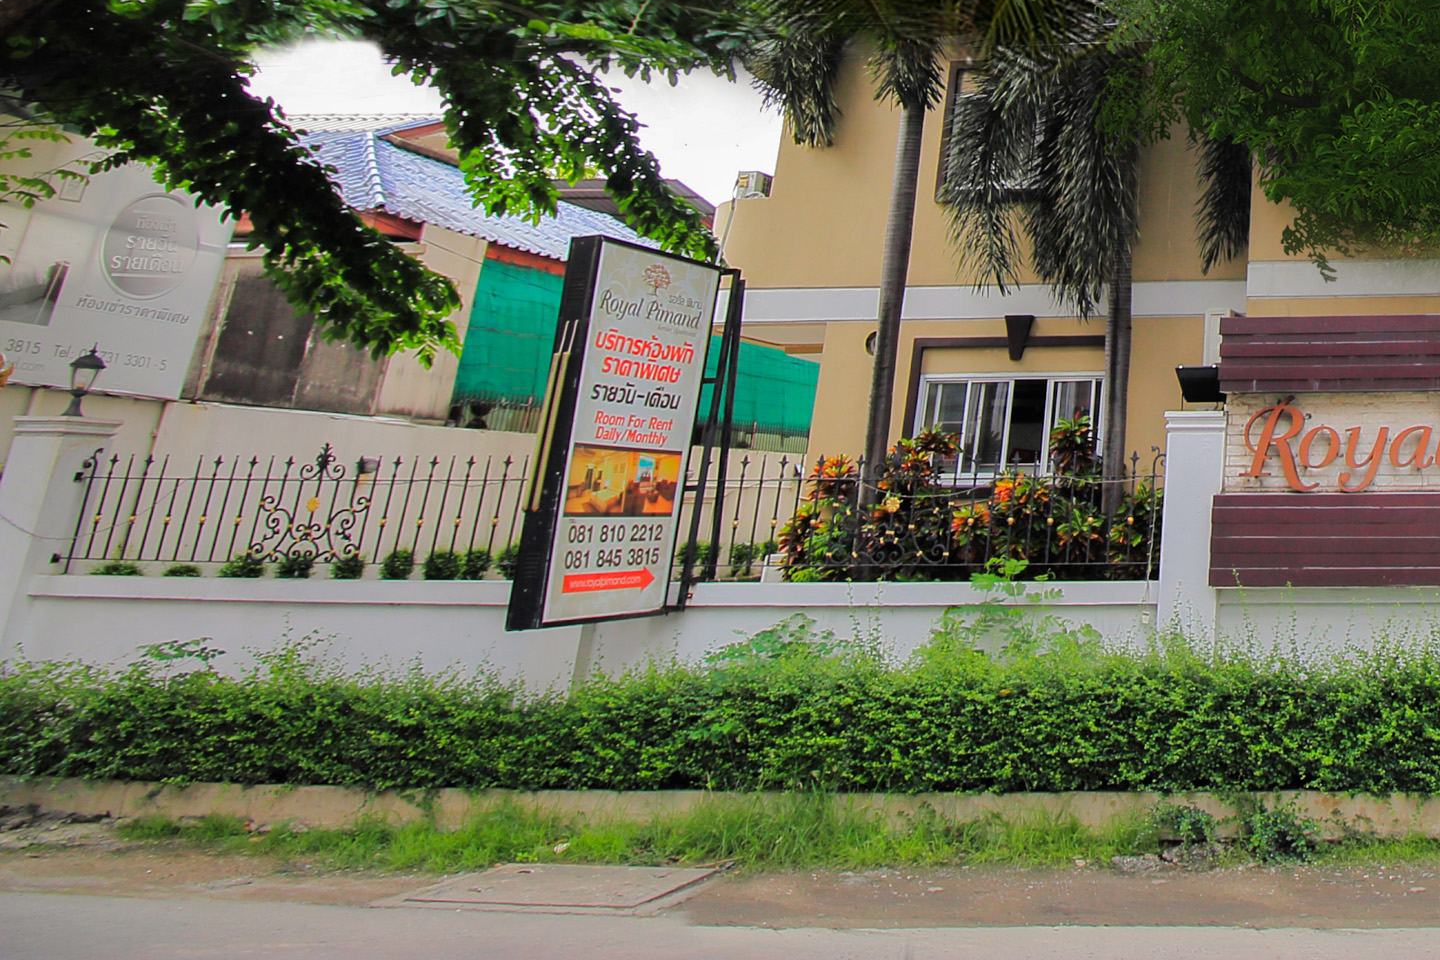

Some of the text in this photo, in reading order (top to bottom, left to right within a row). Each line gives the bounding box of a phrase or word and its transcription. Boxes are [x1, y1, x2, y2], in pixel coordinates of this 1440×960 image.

[125, 234, 178, 254] รายวัน
[111, 253, 184, 274] รายเดือน
[75, 294, 190, 325] ห้องเช่าราคาพิเศษ
[600, 289, 702, 329] Royal Pimand
[4, 339, 42, 355] 3815
[53, 345, 74, 358] Tel:
[595, 328, 694, 364] บริการห้องพัก
[602, 356, 681, 383] ราคาพิเศษ
[591, 382, 681, 410] รายวัน-เดือน
[594, 410, 673, 431] Room For Rent
[595, 426, 668, 447] Daily/Monthly
[568, 523, 664, 543] 081 810 2212
[564, 547, 660, 569] 081 845 3815
